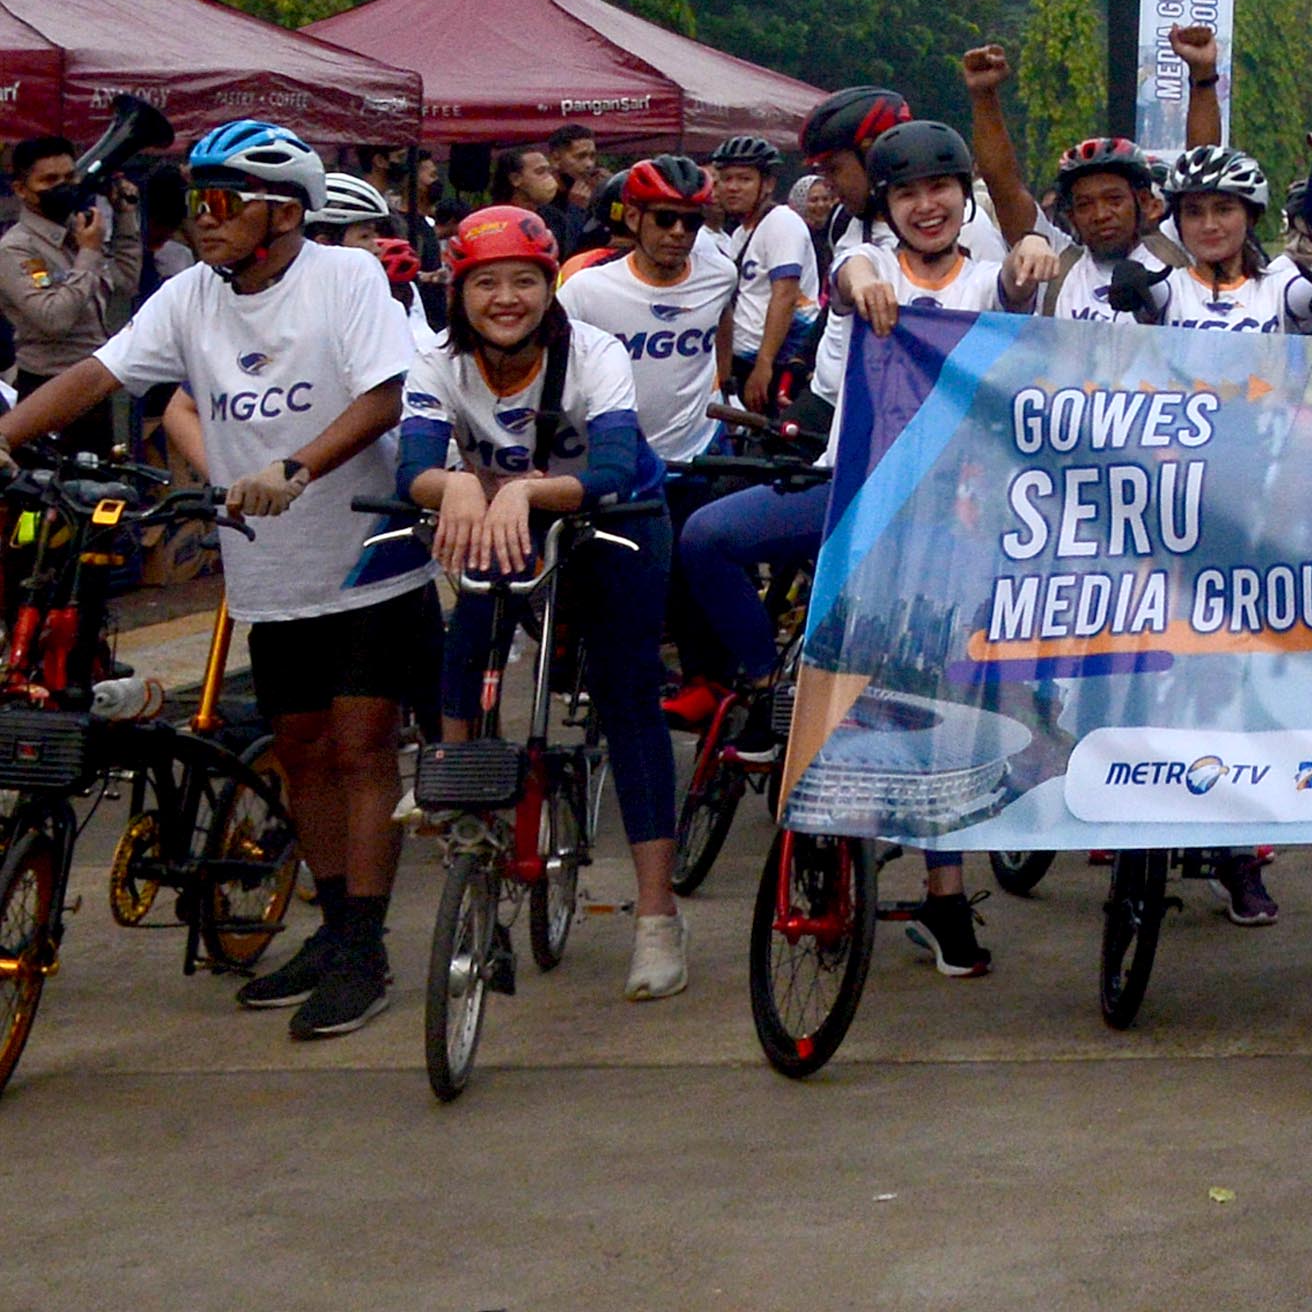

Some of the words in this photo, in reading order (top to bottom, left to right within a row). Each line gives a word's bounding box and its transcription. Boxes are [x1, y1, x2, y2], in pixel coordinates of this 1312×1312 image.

[421, 104, 462, 117] FFEE
[210, 382, 313, 422] MGCC
[1013, 387, 1219, 455] GOWES
[462, 428, 586, 472] MGC
[1002, 459, 1206, 561] SERU
[987, 565, 1169, 642] MEDIA
[1231, 765, 1271, 785] TV
